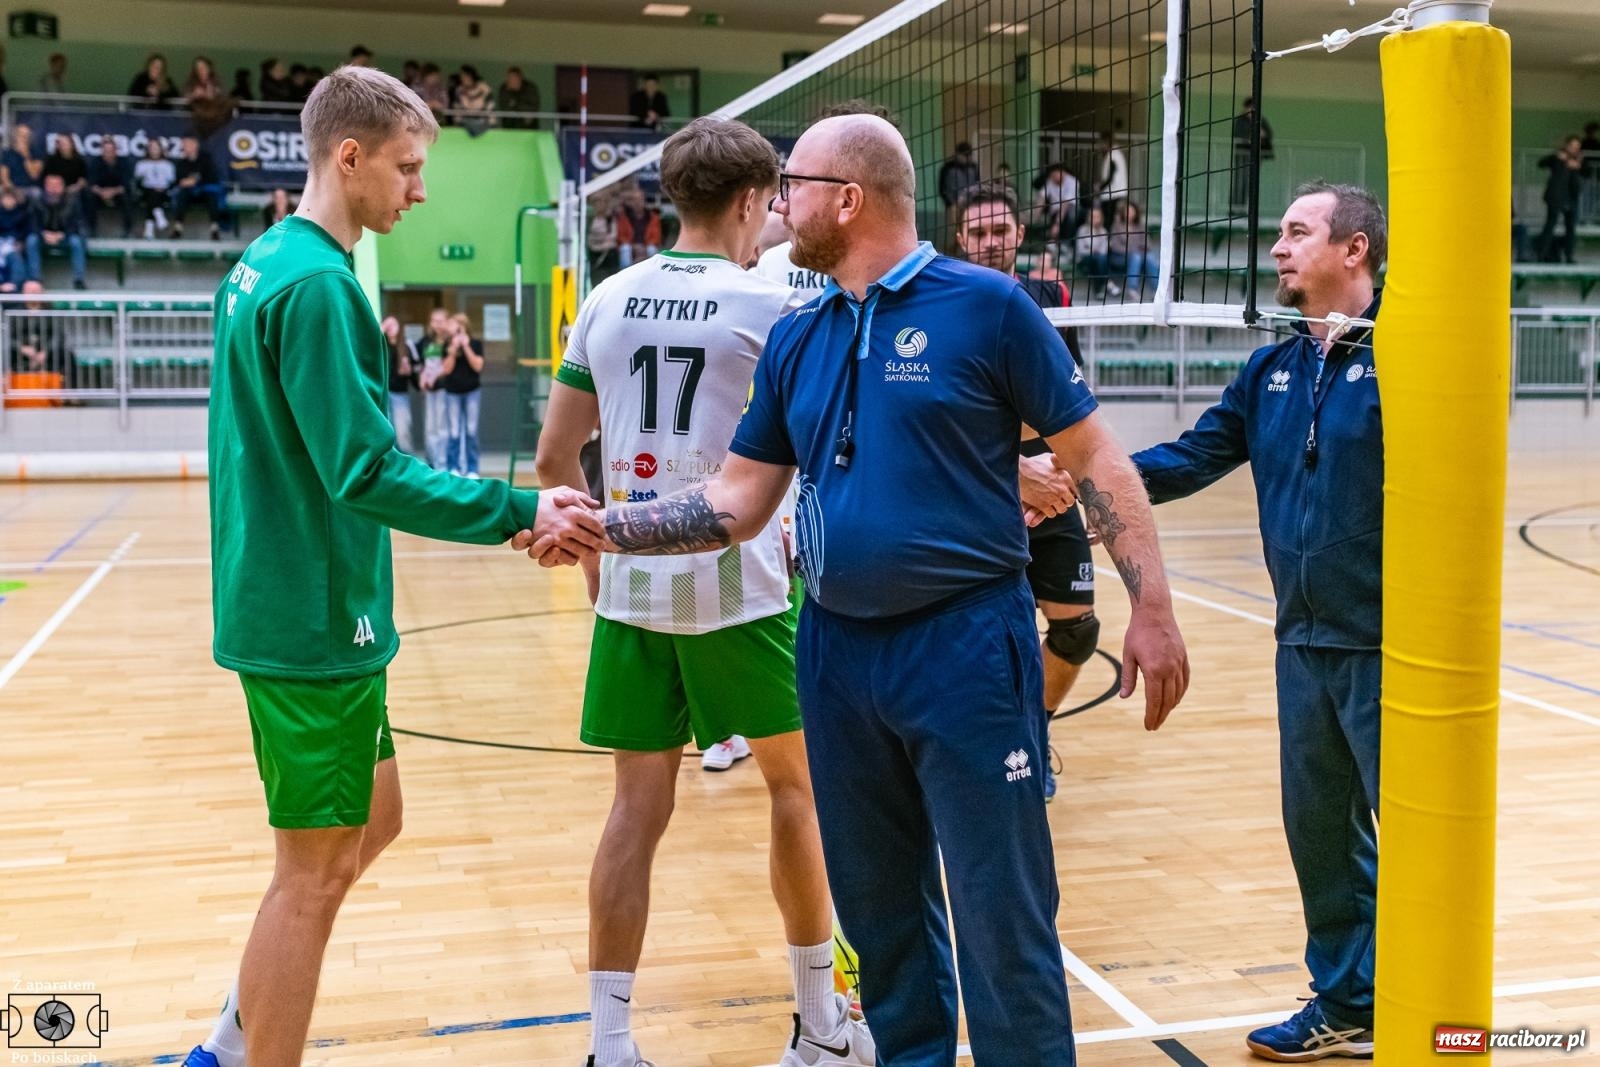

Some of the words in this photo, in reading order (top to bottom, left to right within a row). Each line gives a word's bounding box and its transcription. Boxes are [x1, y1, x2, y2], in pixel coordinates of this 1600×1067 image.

[622, 296, 699, 321] RZYTKI
[702, 300, 718, 321] P
[885, 359, 930, 375] ŚLĄSKA
[884, 373, 930, 383] SIATKÓWKA
[630, 345, 706, 436] 17
[610, 459, 630, 472] adio
[666, 459, 722, 475] SZPUŁA
[353, 614, 375, 647] 44
